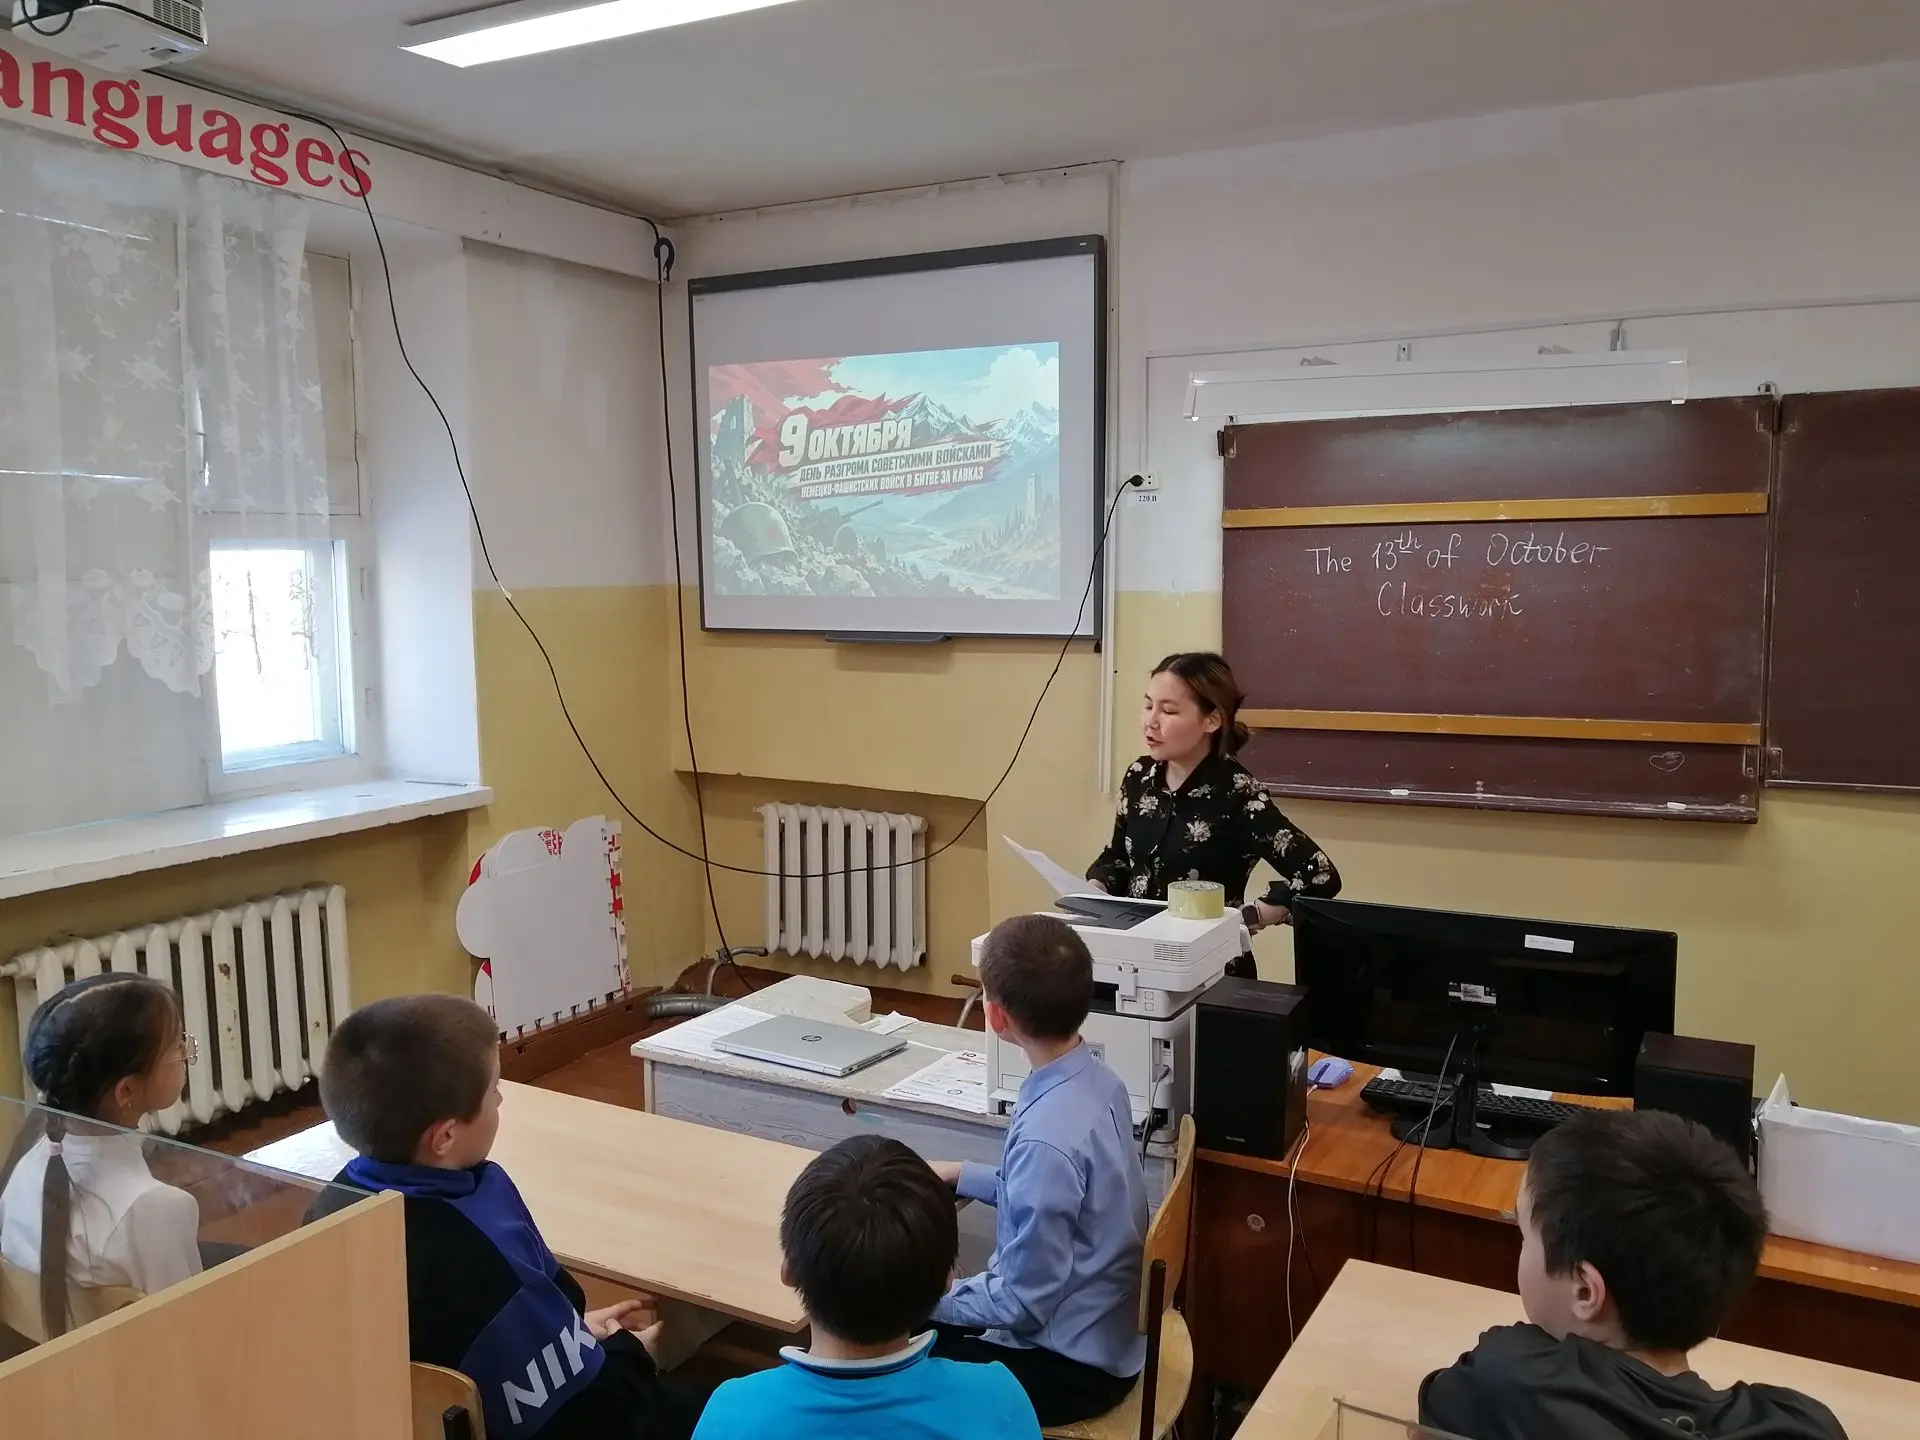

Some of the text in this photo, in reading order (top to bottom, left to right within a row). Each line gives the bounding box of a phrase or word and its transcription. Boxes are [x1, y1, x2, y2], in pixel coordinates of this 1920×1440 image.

[779, 413, 913, 468] 9 ОКТЯБРЯ
[800, 443, 992, 483] ДЕНЬ РАЗГРОМА СОВЕТСКИМИ ВОЙСКАМИ
[801, 465, 984, 499] НЕМЕЦКО-ФАШИСТСКИХ ВОЙСК В БИТВЕ ЗА КАВКАЗ
[1305, 529, 1613, 576] The 13th of October
[1376, 581, 1524, 619] Classwork
